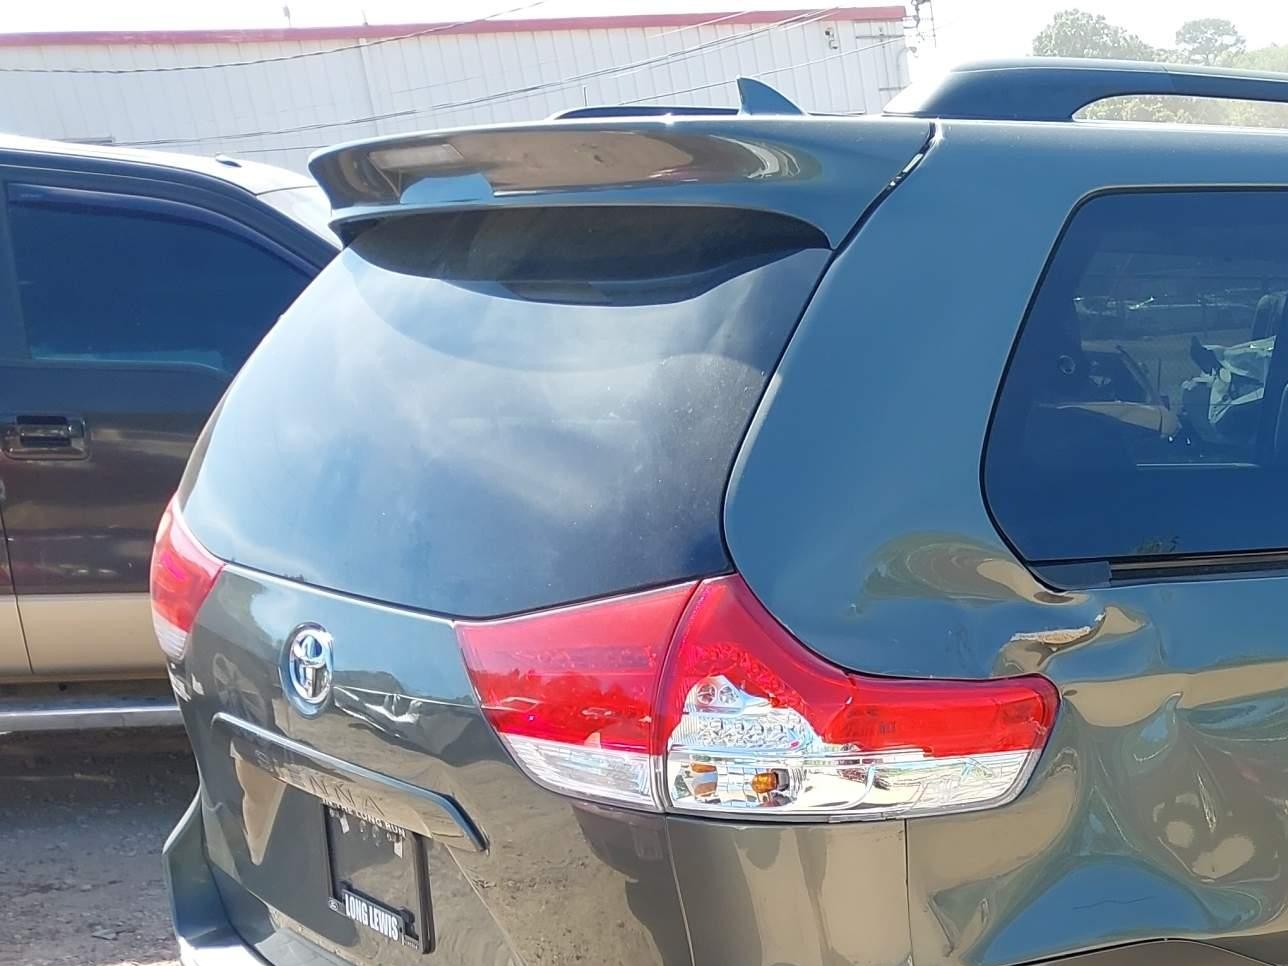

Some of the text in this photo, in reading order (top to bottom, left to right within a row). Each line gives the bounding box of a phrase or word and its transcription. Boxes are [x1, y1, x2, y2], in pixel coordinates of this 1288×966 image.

[355, 809, 383, 828] LONG
[384, 821, 406, 839] RUN
[344, 892, 369, 927] LONG
[368, 904, 400, 942] LEWIS
